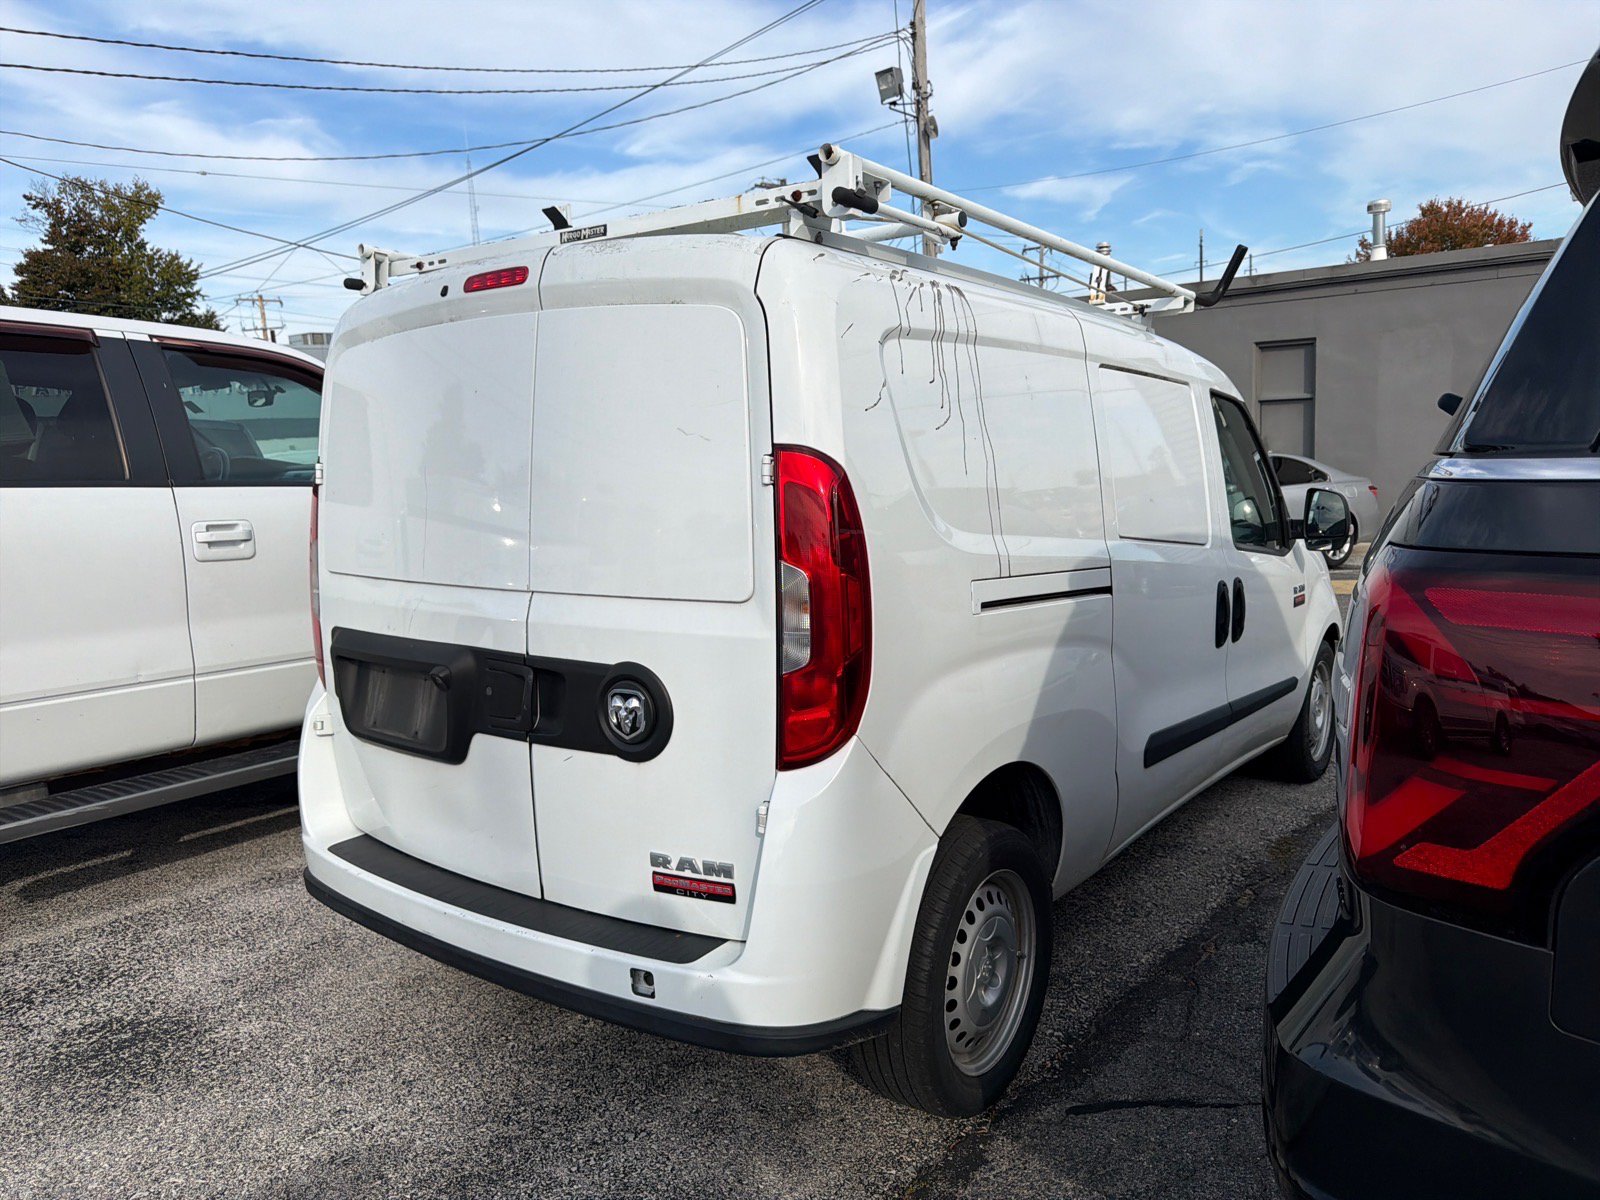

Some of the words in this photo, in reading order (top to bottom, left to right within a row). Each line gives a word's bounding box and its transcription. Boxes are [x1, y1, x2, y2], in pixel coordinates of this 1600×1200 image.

[580, 226, 605, 240] MASTER
[649, 851, 735, 880] RAM
[676, 888, 709, 899] CITY
